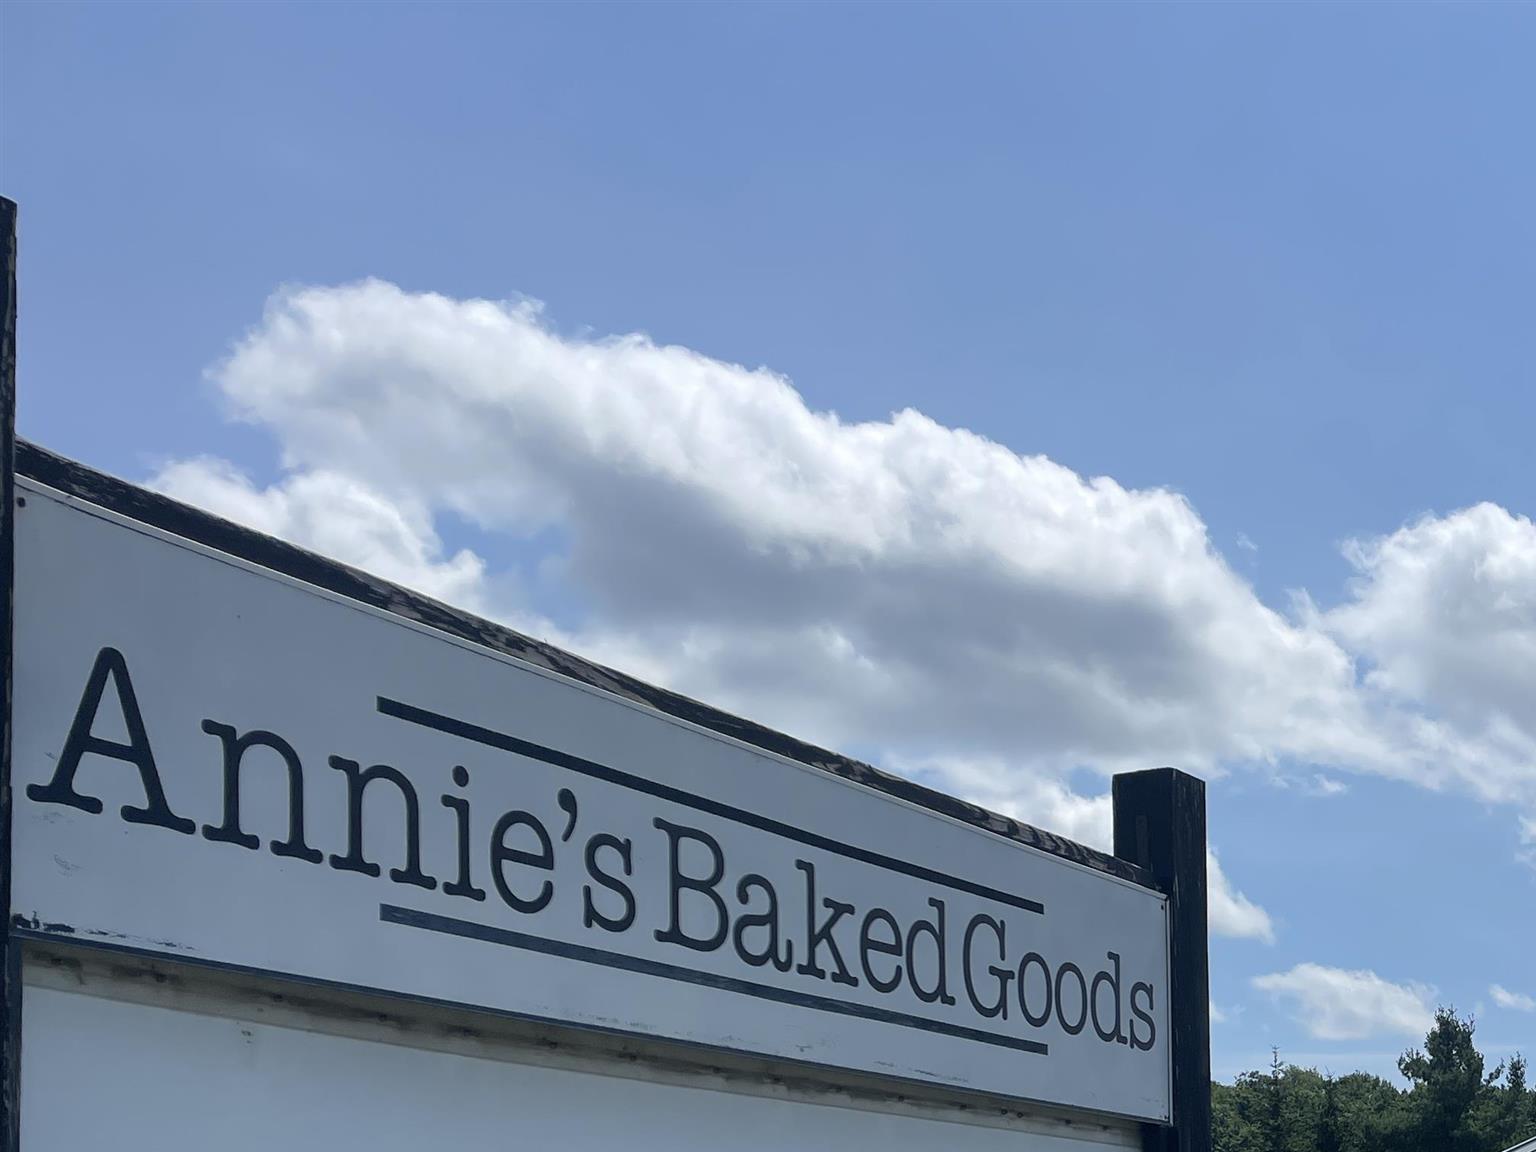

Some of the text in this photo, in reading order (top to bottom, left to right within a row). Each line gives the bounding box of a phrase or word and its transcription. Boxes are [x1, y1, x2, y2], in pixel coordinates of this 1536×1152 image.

[26, 646, 1157, 1052] Annie's Baked Goods
